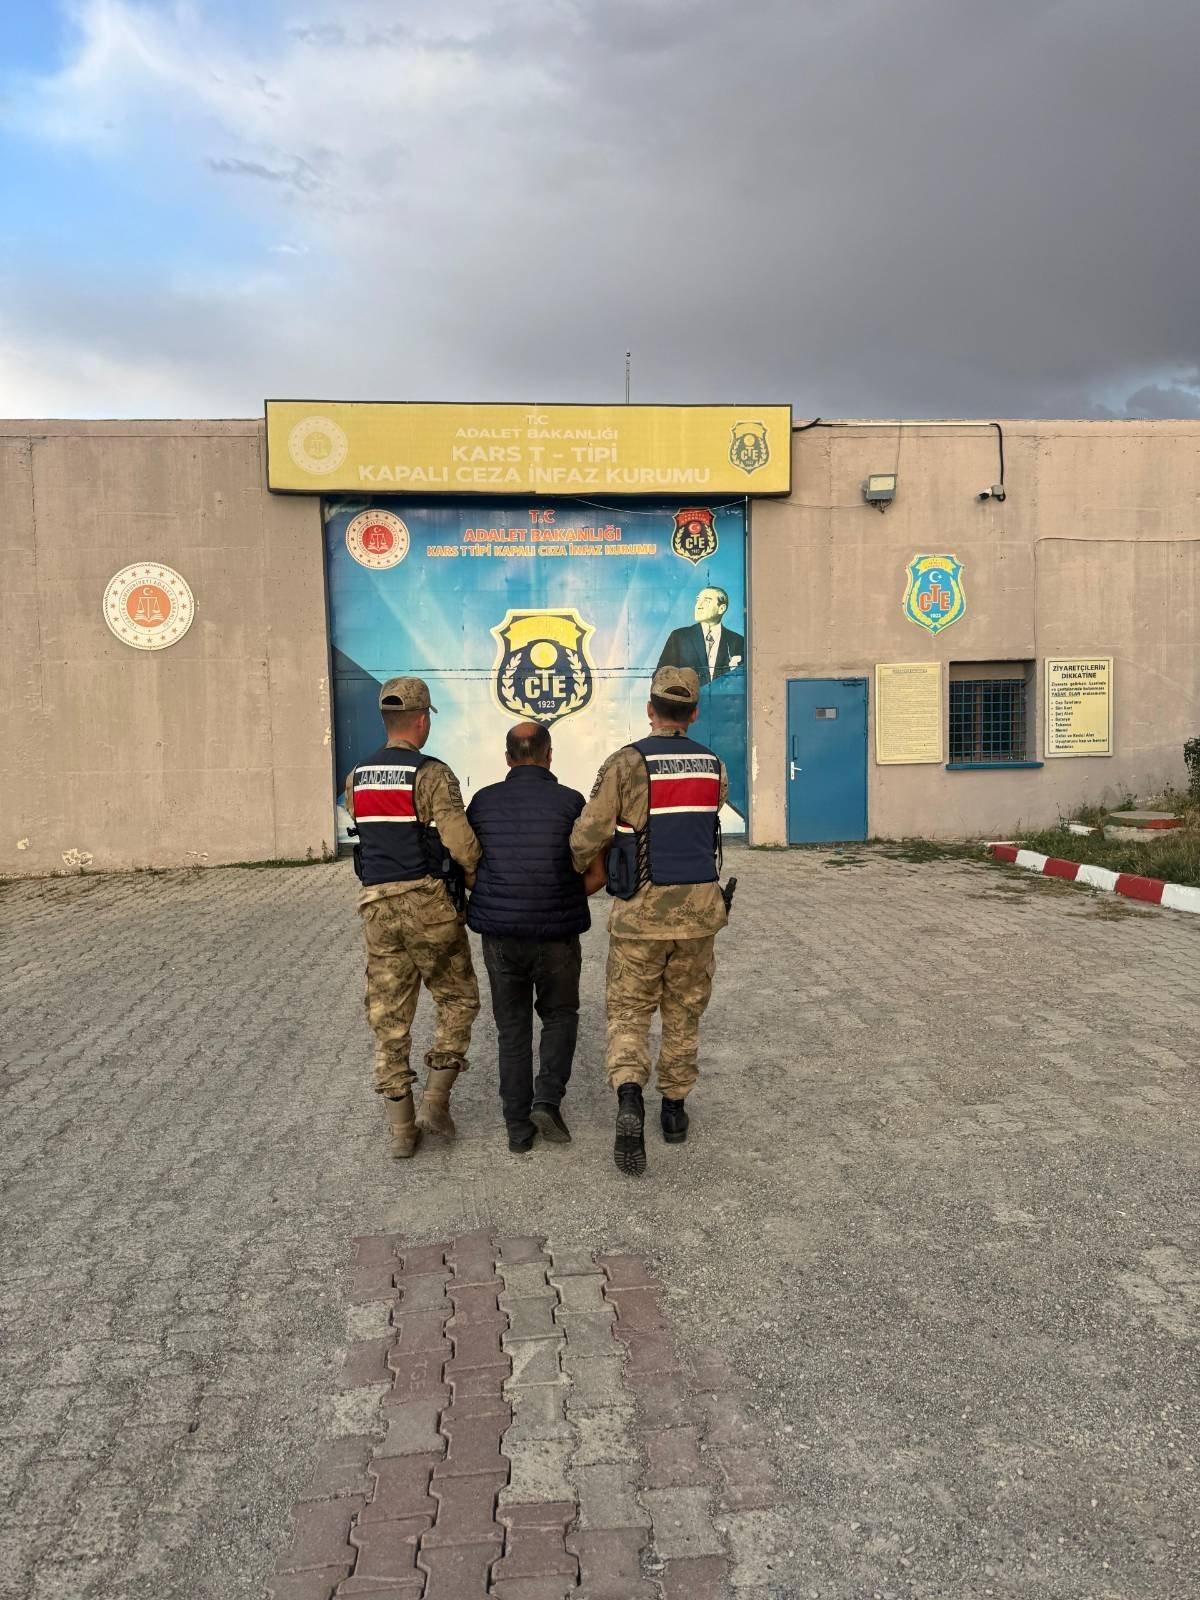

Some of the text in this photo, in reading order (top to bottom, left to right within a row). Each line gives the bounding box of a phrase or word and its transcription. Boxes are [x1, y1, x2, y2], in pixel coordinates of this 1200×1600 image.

[455, 426, 618, 440] ADALET BAKANLIĞI
[452, 446, 521, 462] KARS
[528, 446, 545, 462] T
[571, 443, 617, 463] TİPİ
[740, 446, 758, 460] CTE
[358, 464, 710, 484] KAPALI CEZA İNFAZ KURUMU
[529, 509, 556, 524] T.C
[464, 524, 622, 542] ADALET BAKANLIĞI
[686, 534, 705, 548] CTE
[426, 546, 459, 556] KARS
[494, 546, 536, 557] KAPALI
[538, 545, 567, 556] CEZA
[569, 543, 602, 556] İNFAZ
[605, 544, 657, 555] KURUMU
[919, 584, 950, 612] CTE
[524, 669, 566, 699] CTE
[652, 760, 714, 774] JANDARMA
[360, 770, 406, 784] JANDARMA
